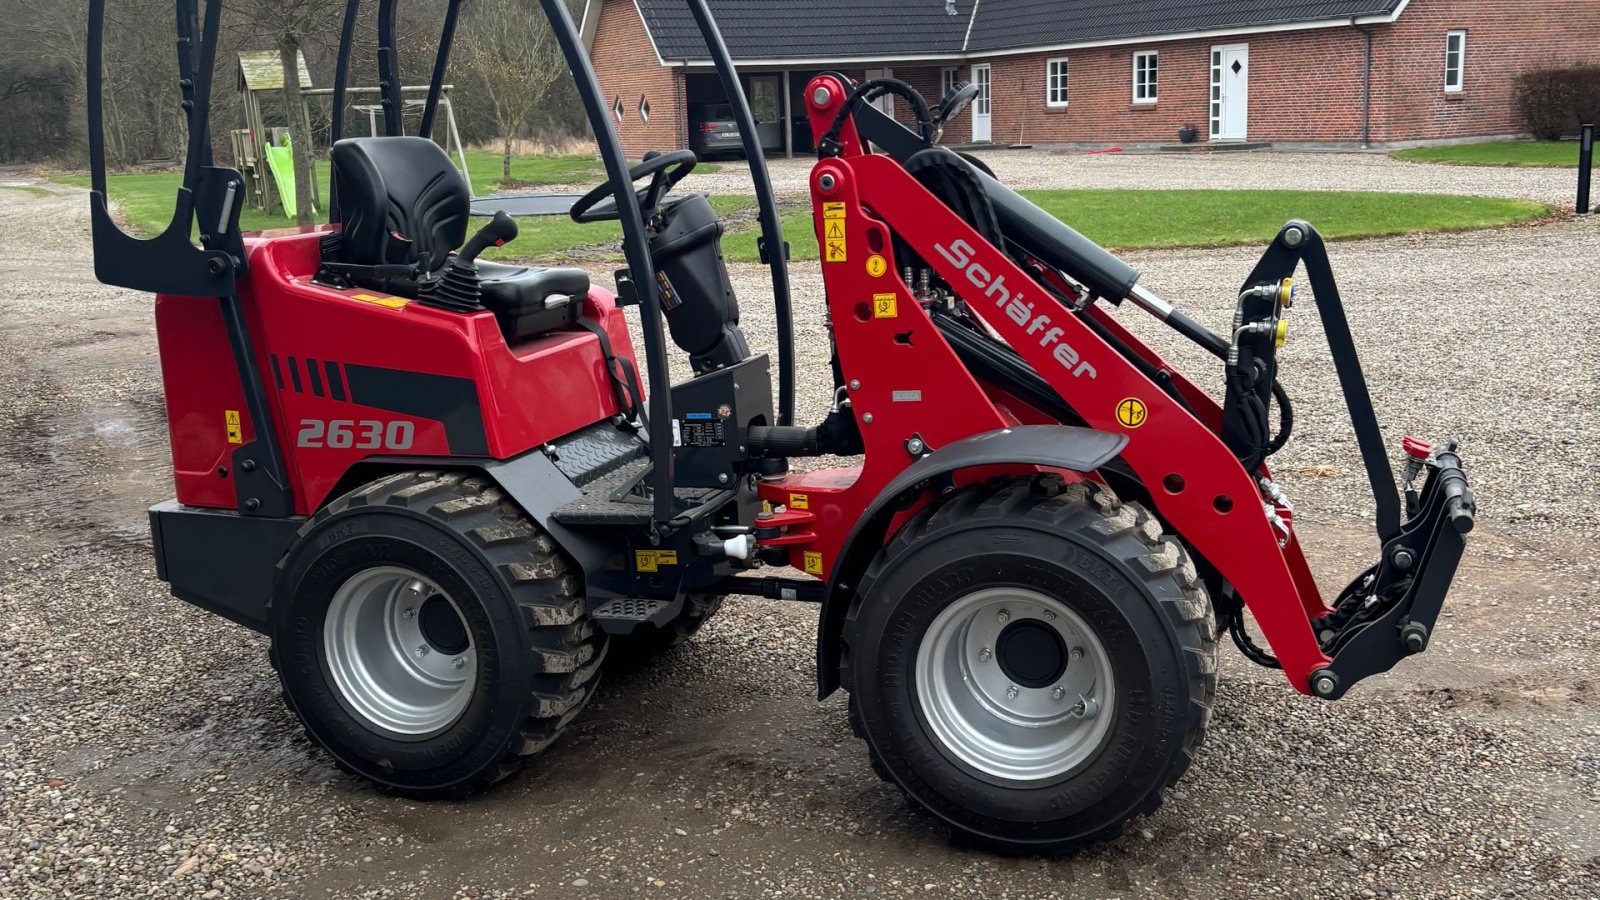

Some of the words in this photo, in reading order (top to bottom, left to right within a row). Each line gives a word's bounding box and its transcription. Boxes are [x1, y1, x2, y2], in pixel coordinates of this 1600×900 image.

[934, 239, 1097, 379] Schäffer
[297, 419, 415, 450] 2630
[327, 521, 356, 543] BKT
[1078, 553, 1119, 586] BKT
